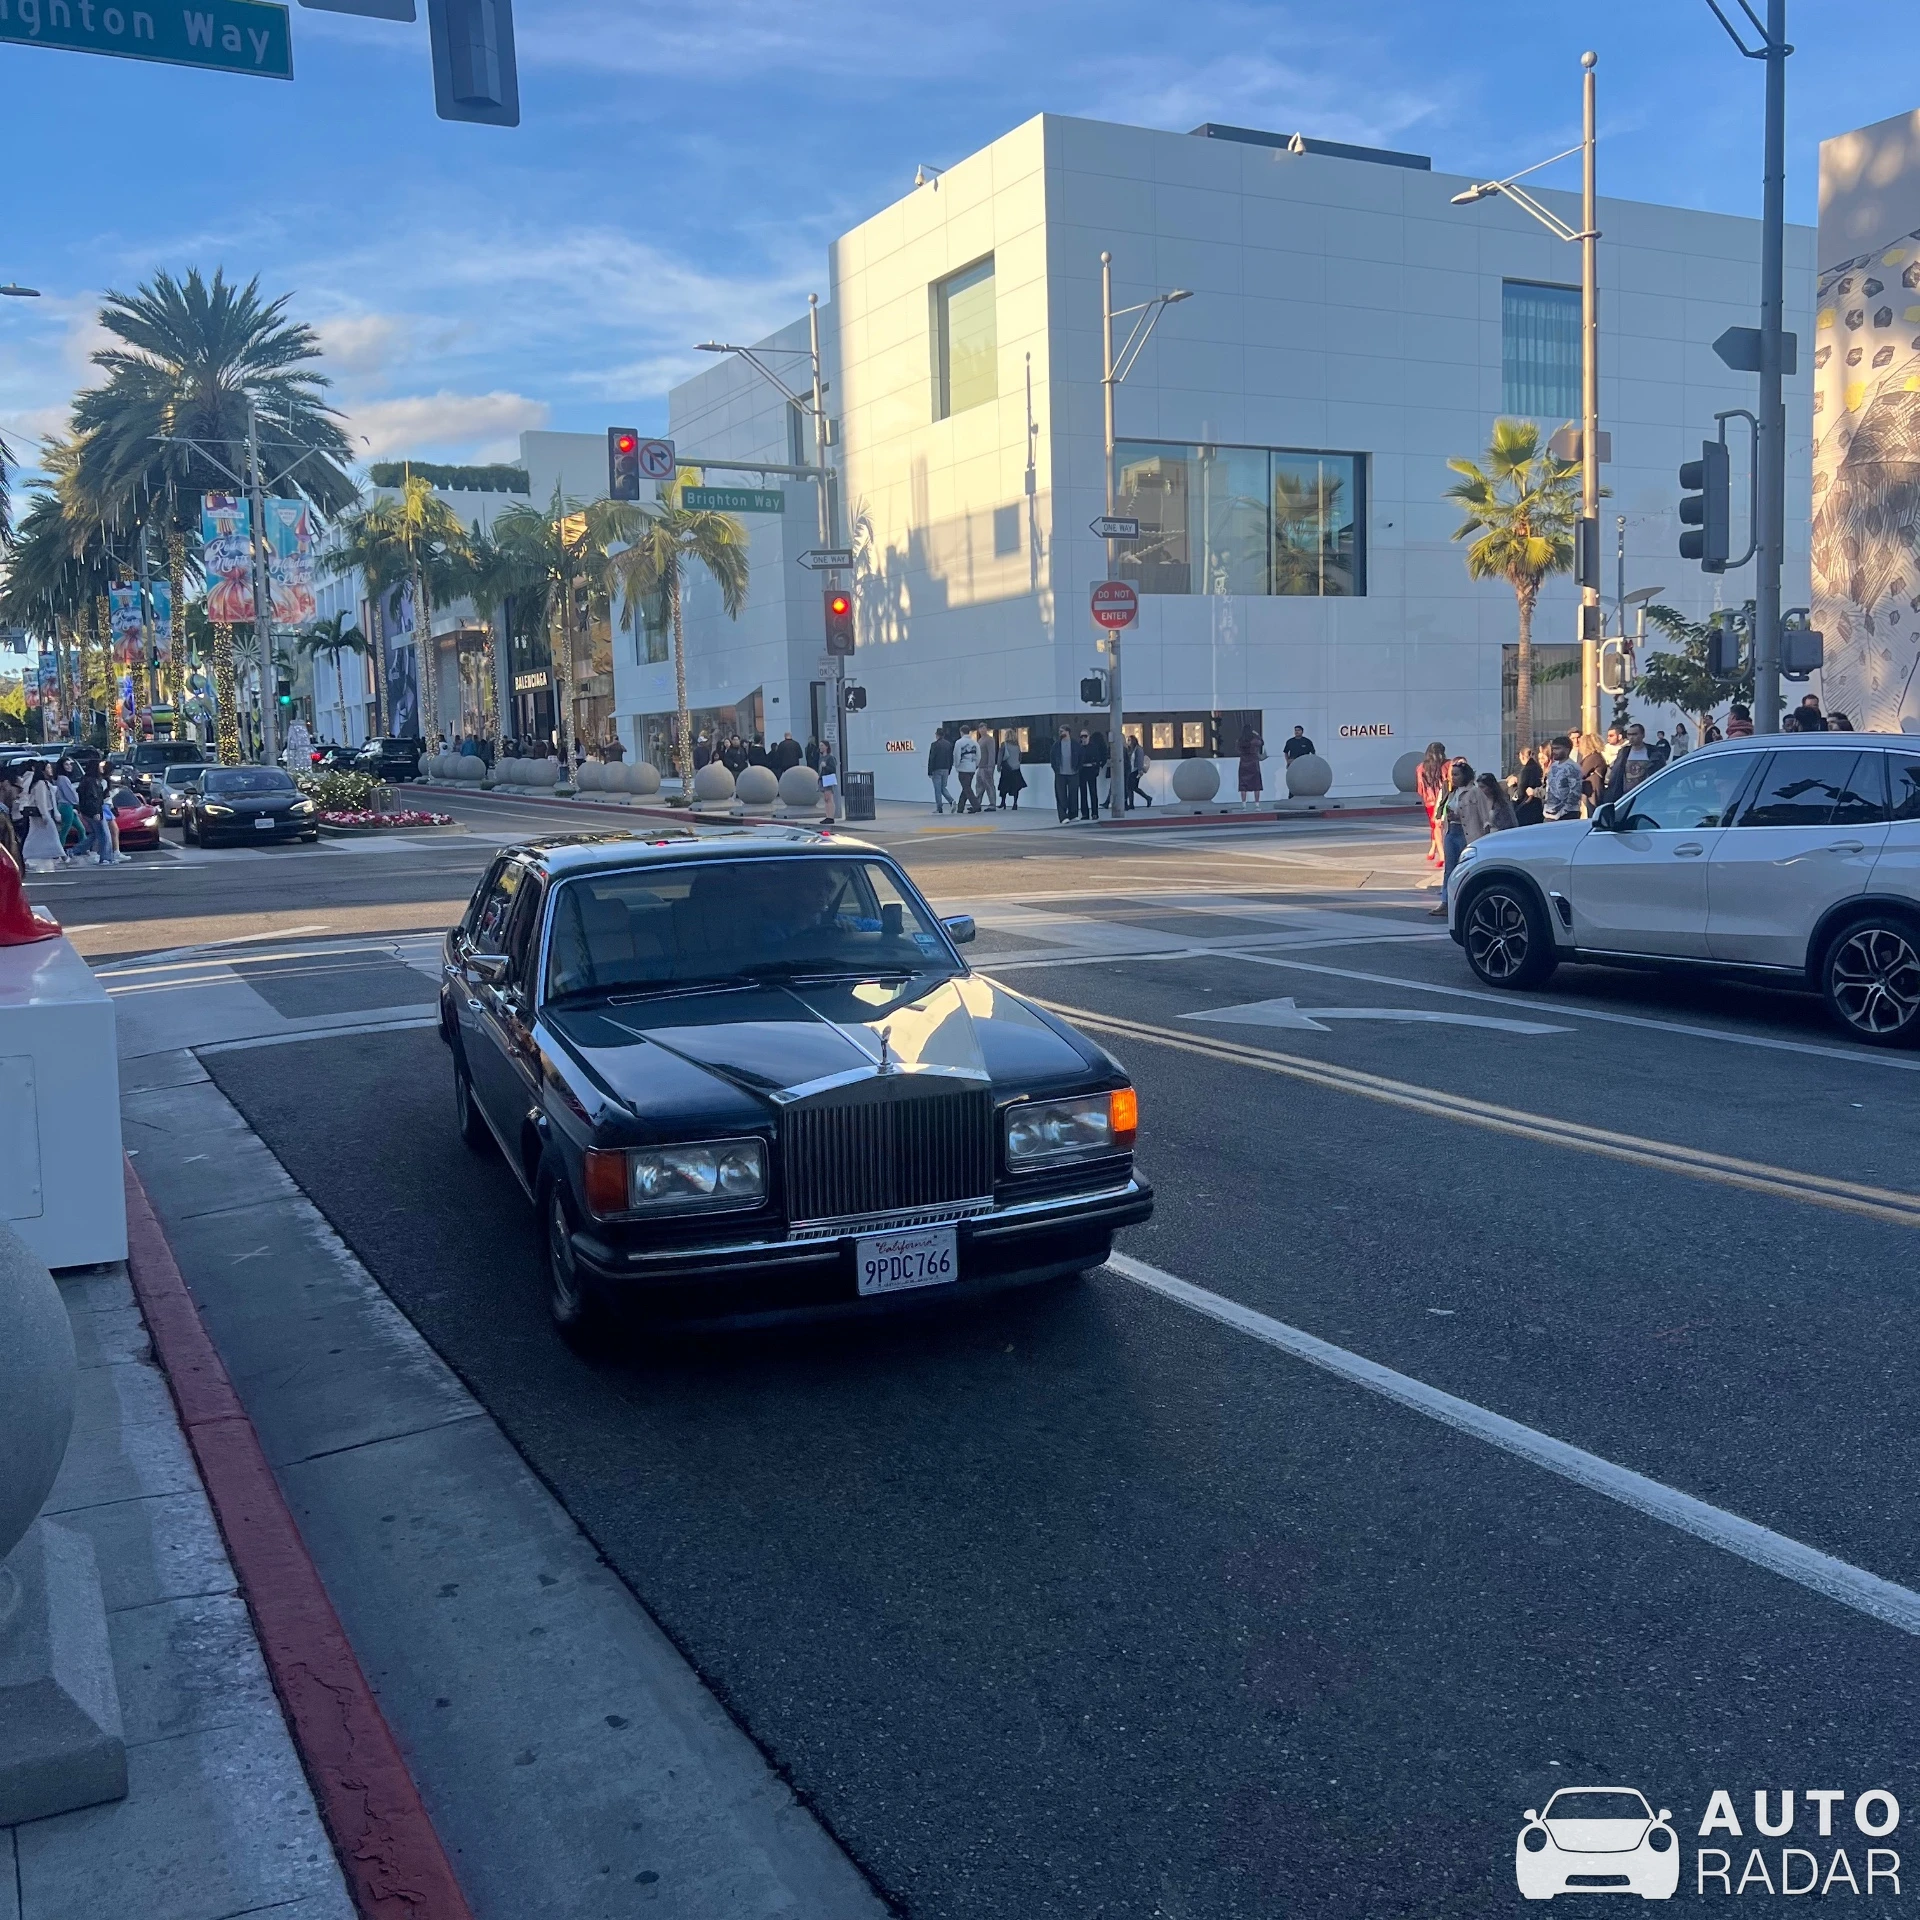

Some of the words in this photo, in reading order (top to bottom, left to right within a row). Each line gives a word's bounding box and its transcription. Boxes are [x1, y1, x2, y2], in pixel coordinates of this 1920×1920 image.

[183, 9, 270, 65] Way
[687, 492, 747, 509] Brighton
[754, 494, 780, 511] Way
[1103, 523, 1117, 532] ONE
[1119, 524, 1133, 533] WAY
[813, 556, 828, 564] ONE
[1098, 590, 1110, 599] DO
[1114, 590, 1130, 599] NOT
[1101, 611, 1128, 621] ENTER
[514, 671, 548, 691] BALENCIAGA
[1340, 724, 1394, 737] CHANEL
[885, 740, 915, 752] CHANEL
[865, 1248, 951, 1286] 9PDC766
